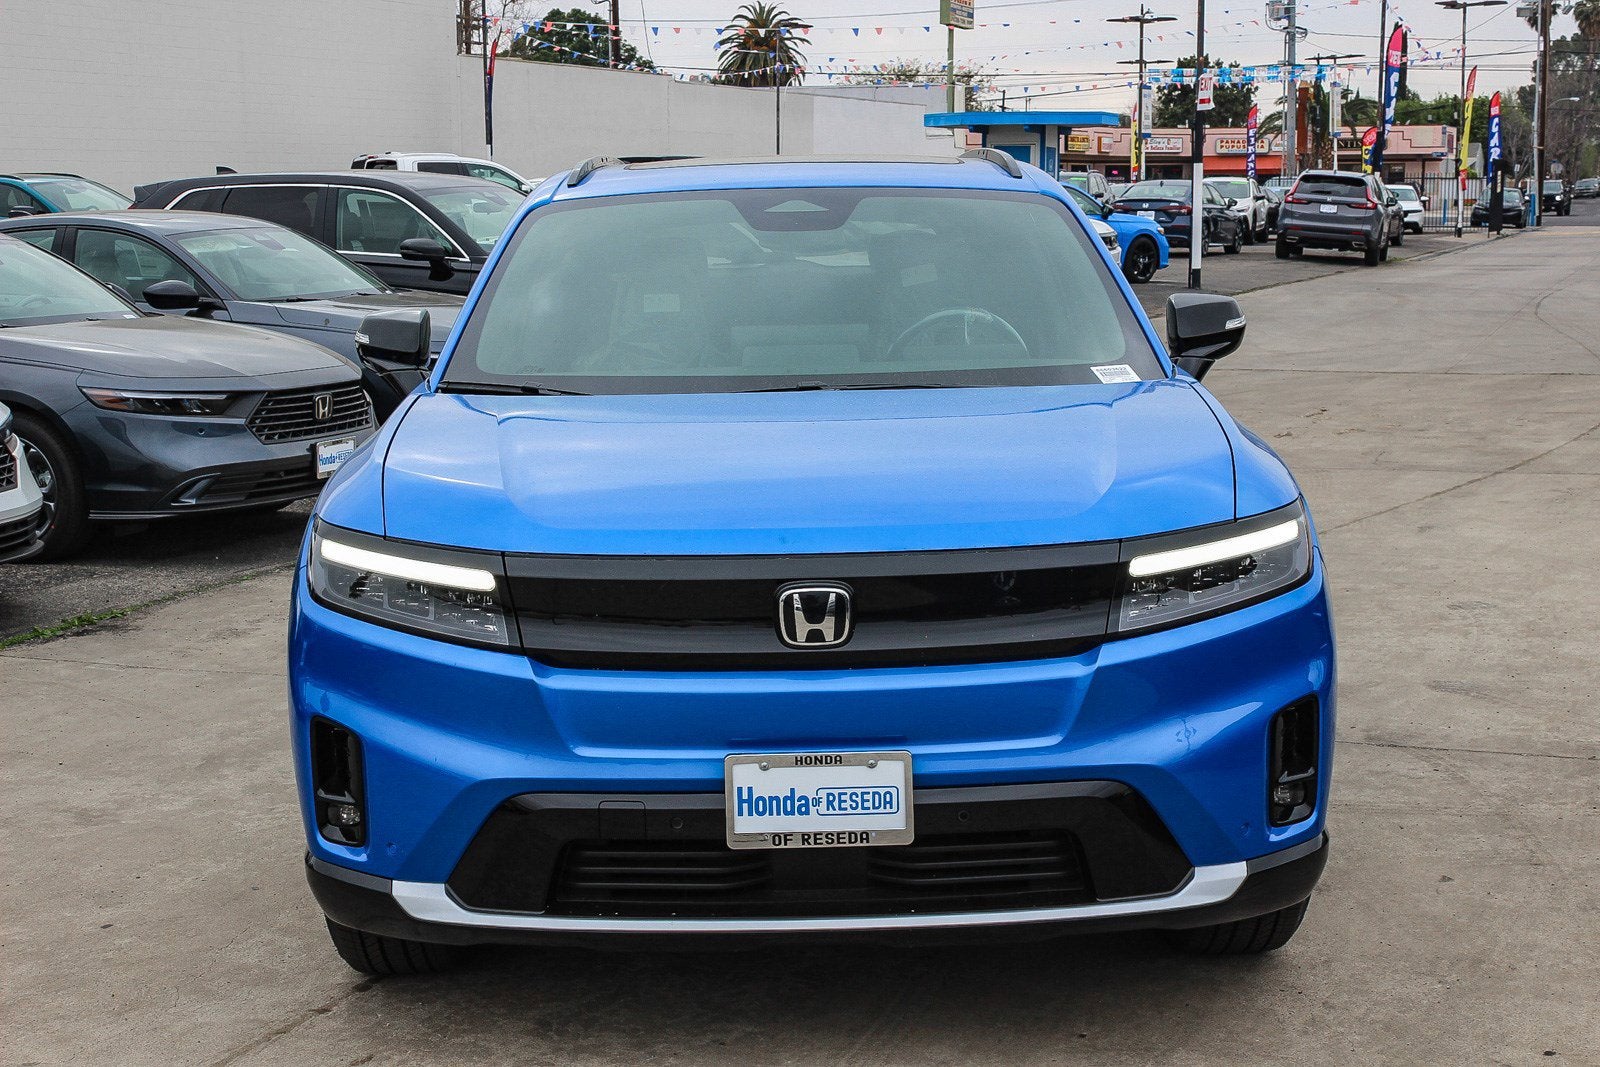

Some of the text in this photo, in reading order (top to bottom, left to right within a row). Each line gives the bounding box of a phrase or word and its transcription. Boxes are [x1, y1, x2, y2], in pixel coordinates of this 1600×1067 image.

[794, 755, 843, 766] HONDA
[736, 786, 894, 817] Honda OF RESEDA
[771, 831, 871, 847] OF RESEDA
